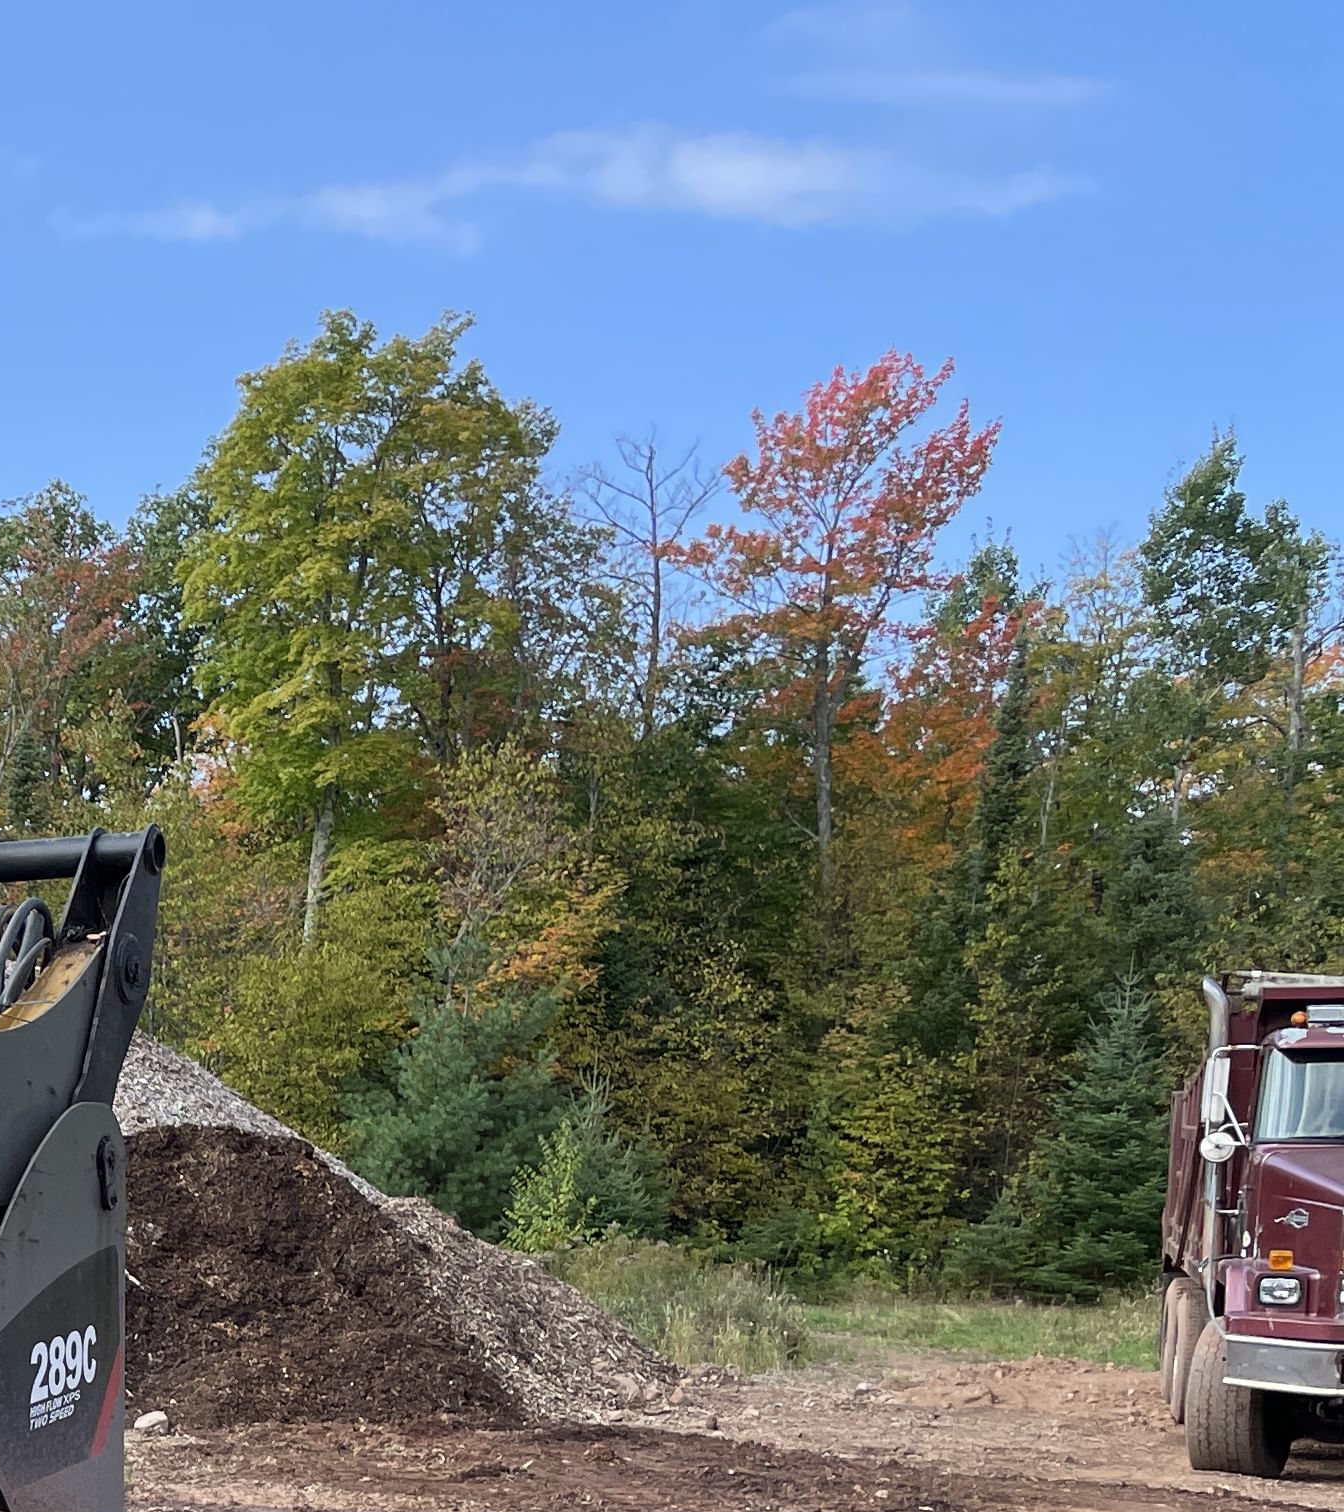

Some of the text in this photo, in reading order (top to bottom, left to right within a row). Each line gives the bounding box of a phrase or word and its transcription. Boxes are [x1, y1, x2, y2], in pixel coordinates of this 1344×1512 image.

[30, 1325, 97, 1404] 289C
[30, 1389, 81, 1418] HIGH FLOW XPS
[30, 1404, 75, 1431] TWO SPEED
